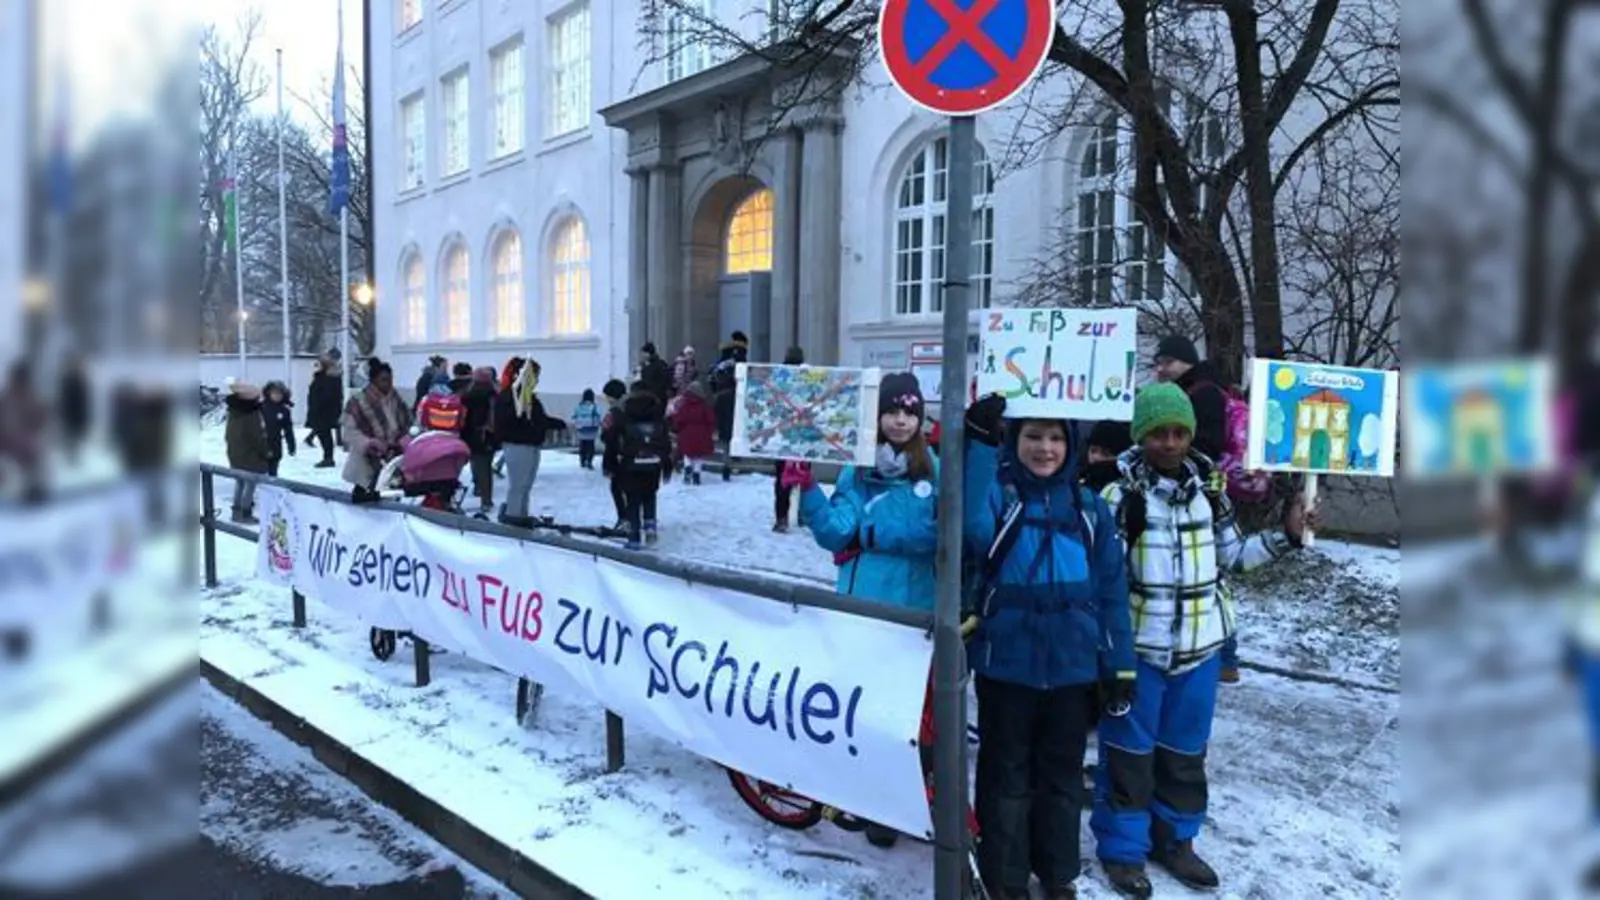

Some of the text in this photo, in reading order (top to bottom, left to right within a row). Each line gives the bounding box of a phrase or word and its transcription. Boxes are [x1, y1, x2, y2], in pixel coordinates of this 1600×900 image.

[988, 313, 1013, 331] Zu
[1077, 322, 1118, 337] zur
[1001, 340, 1135, 403] Schule!
[309, 524, 347, 577] Wir
[349, 543, 430, 597] gehen
[437, 564, 472, 615] zu
[553, 598, 632, 665] zur
[643, 622, 862, 756] Schule!
